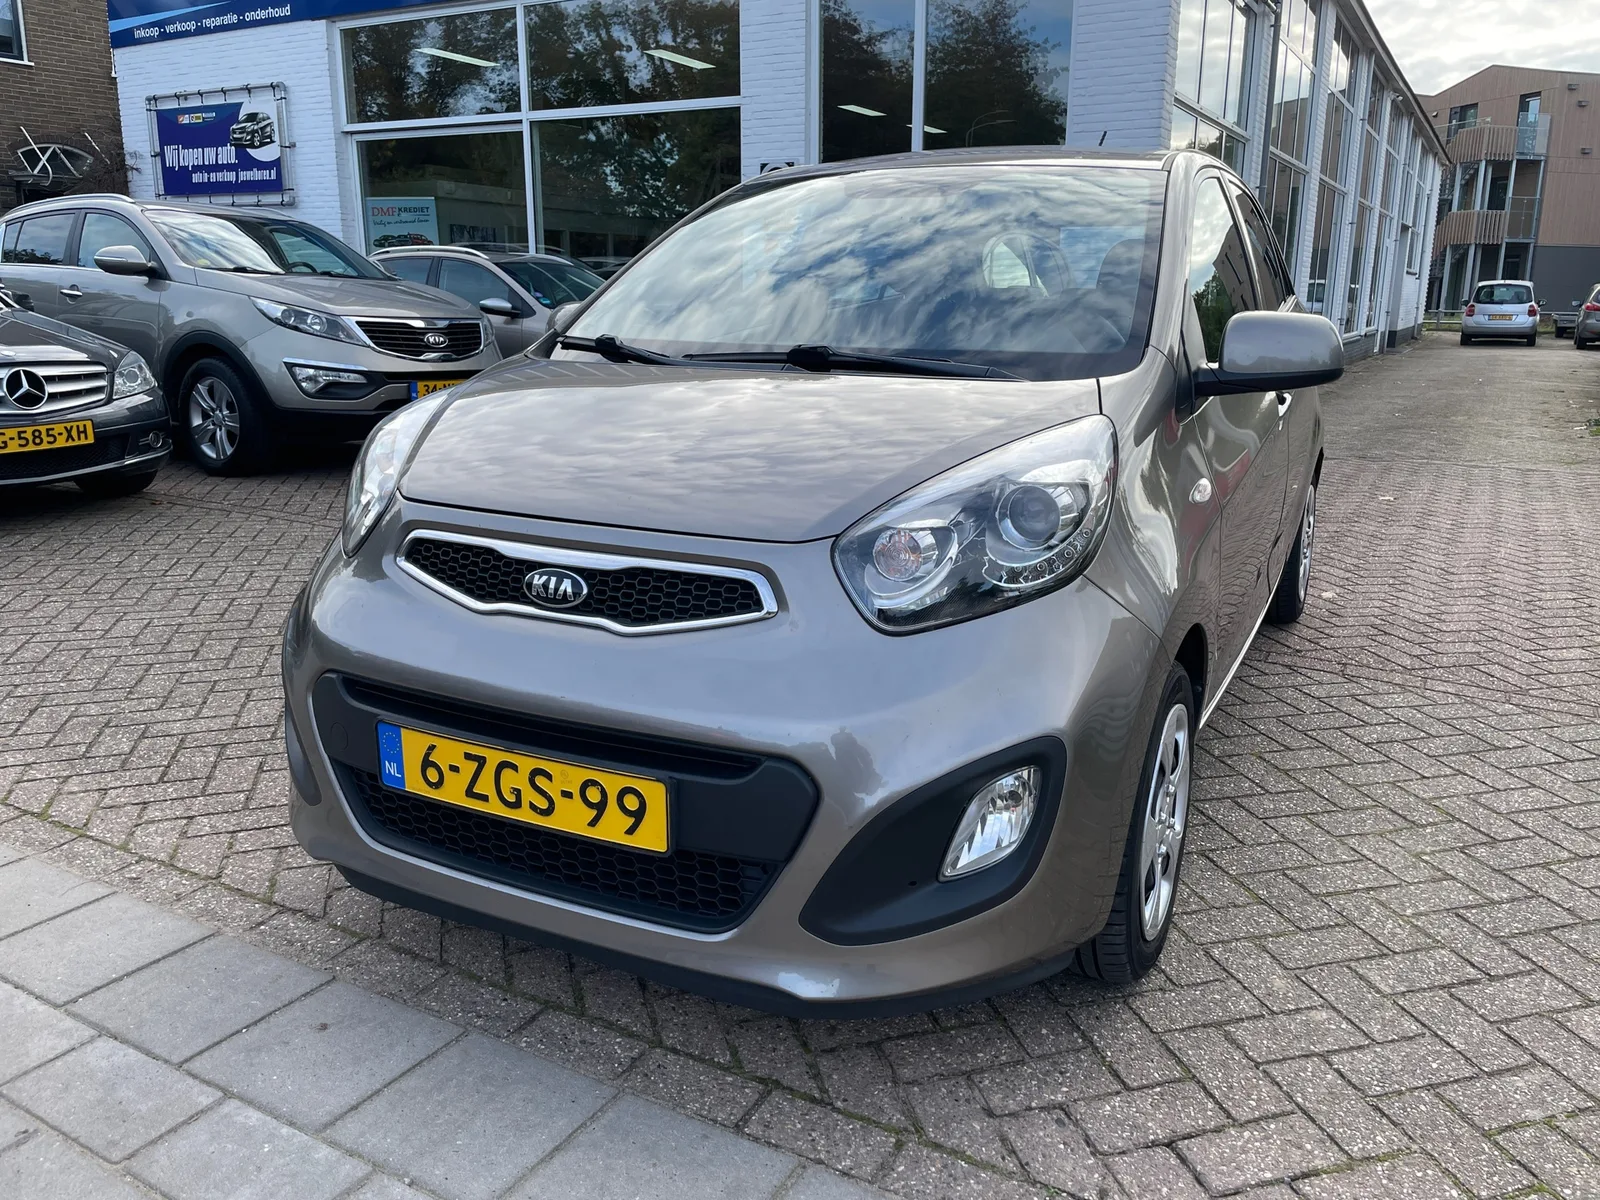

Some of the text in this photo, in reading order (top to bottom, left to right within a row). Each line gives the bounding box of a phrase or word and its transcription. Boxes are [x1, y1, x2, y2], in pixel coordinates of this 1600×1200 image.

[134, 28, 159, 39] inkoop
[165, 20, 196, 34] verkoop
[202, 12, 238, 29] reparatie
[245, 4, 291, 21] onderhoud
[164, 143, 238, 171] Wij kopen uw auto.
[372, 206, 430, 216] DMF KREDIET
[429, 336, 444, 344] KIA
[0, 424, 88, 450] G-585-XH
[532, 574, 574, 600] KIA
[385, 760, 402, 778] NL
[420, 743, 648, 836] 6-ZGS-99
